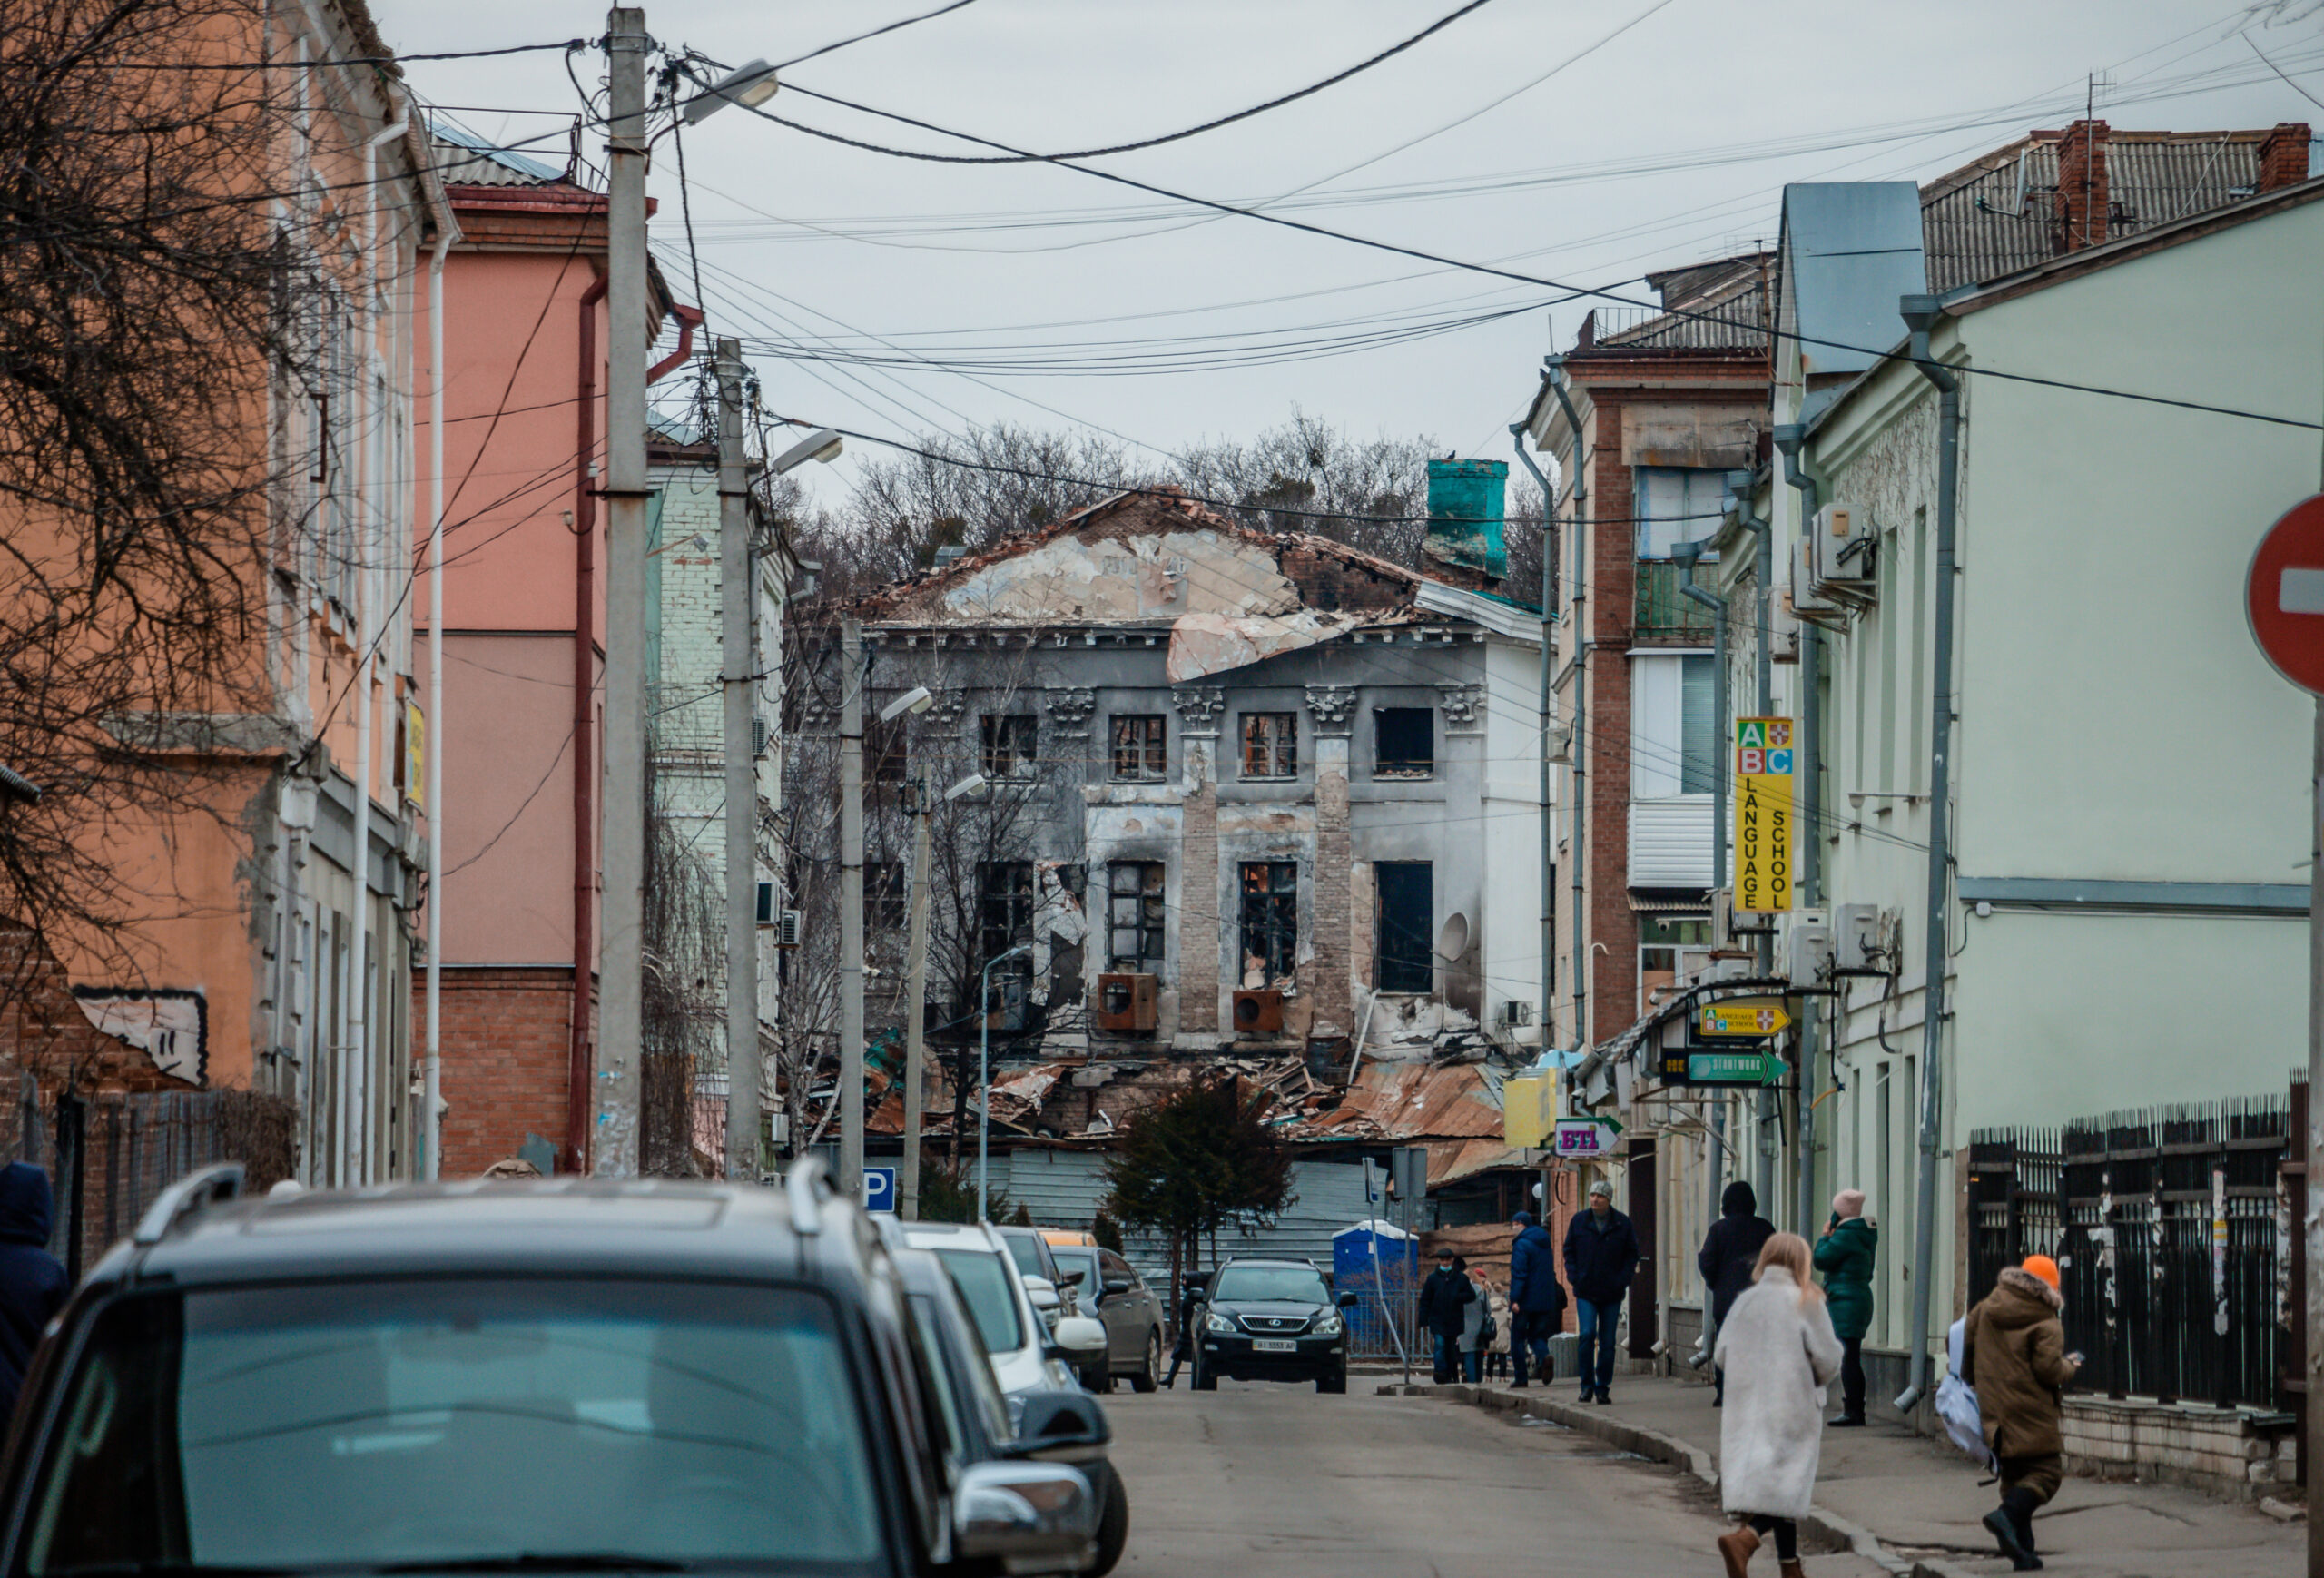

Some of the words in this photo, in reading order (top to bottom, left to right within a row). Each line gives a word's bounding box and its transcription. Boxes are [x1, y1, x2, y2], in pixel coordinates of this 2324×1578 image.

[1744, 777, 1758, 909] LANGUAGE
[1771, 811, 1786, 910] SCHOOL
[863, 1172, 887, 1208] P
